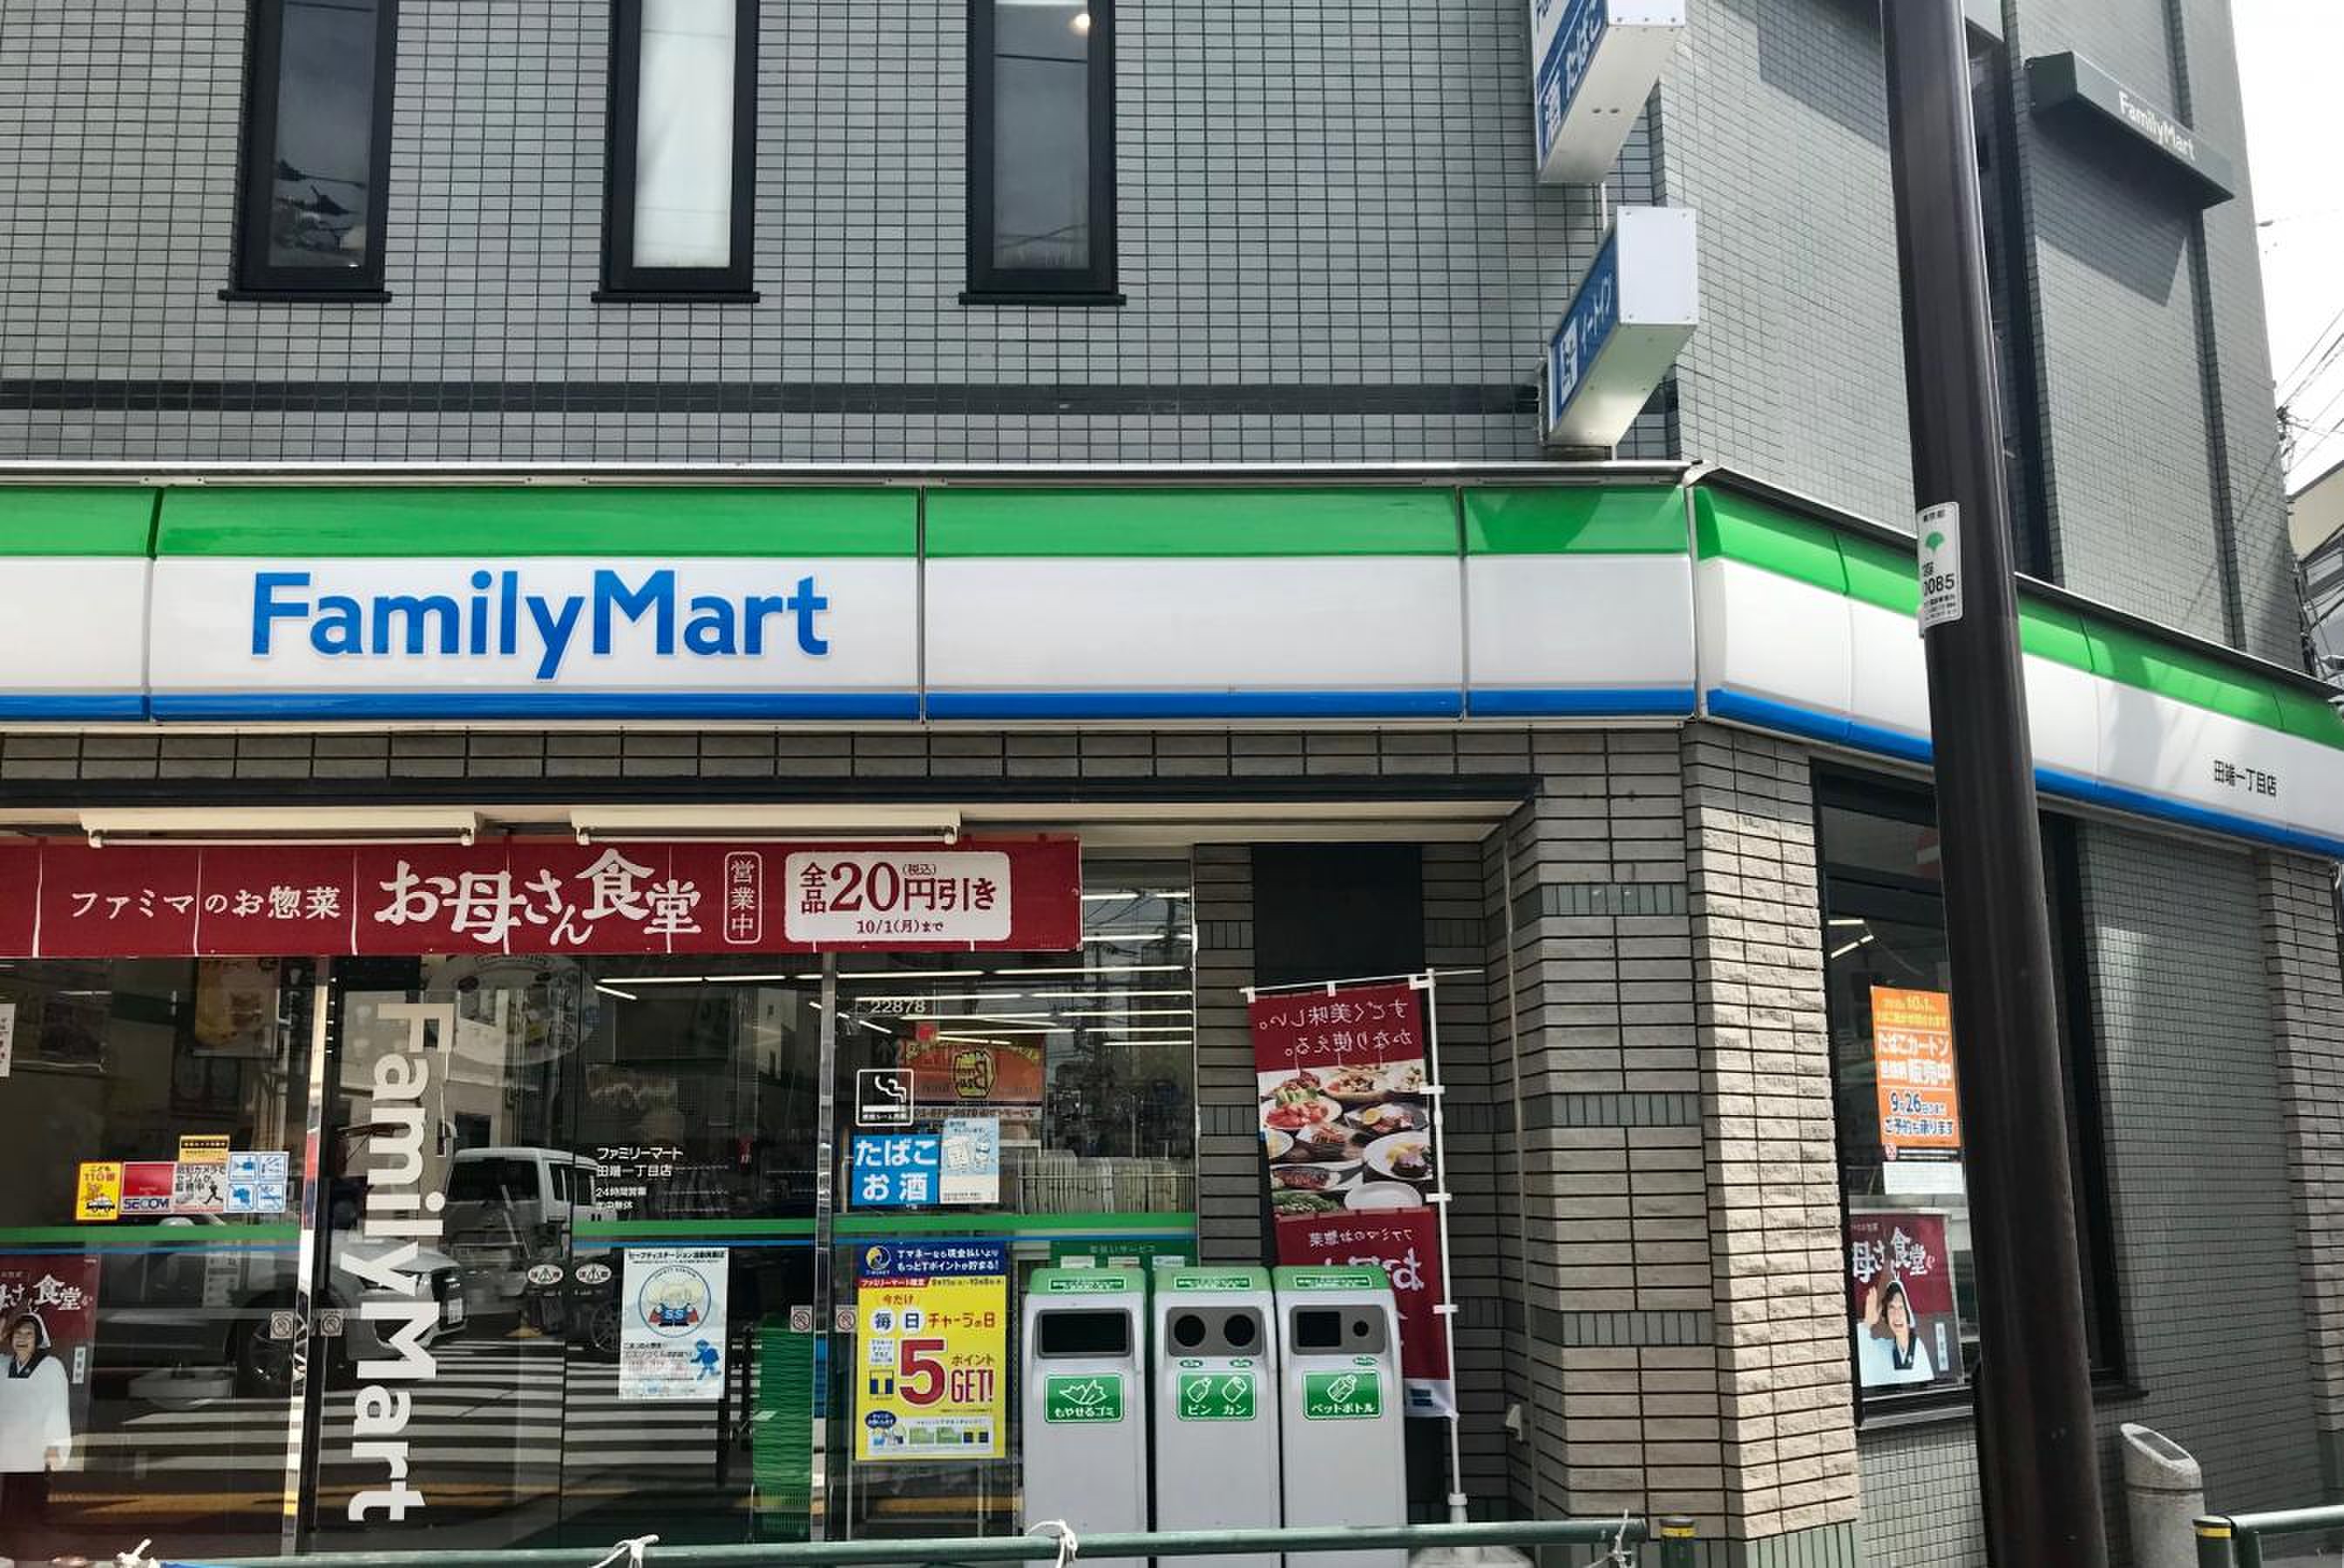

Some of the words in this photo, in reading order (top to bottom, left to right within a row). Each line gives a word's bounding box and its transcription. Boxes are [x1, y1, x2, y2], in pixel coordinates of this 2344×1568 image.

[2118, 90, 2195, 161] FamilyMart
[251, 569, 829, 681] FamilyMart
[2214, 760, 2277, 797] 田端一丁目店
[71, 886, 340, 920] ファミマのお惣菜
[374, 848, 702, 946] お母さん食堂
[730, 860, 756, 938] 営業中
[857, 919, 944, 935] 10/1(月)まで
[597, 1146, 684, 1160] ファミリーマート
[856, 1139, 937, 1167] たばこ
[596, 1163, 673, 1178] 田端一丁目店
[863, 1172, 927, 1202] お酒
[899, 1338, 945, 1406] 5
[951, 1353, 995, 1367] ポイント
[951, 1368, 994, 1403] GET!
[1055, 1405, 1115, 1418] もやせるゴミ
[1223, 1403, 1247, 1416] カン
[1311, 1403, 1375, 1414] ペットボトル
